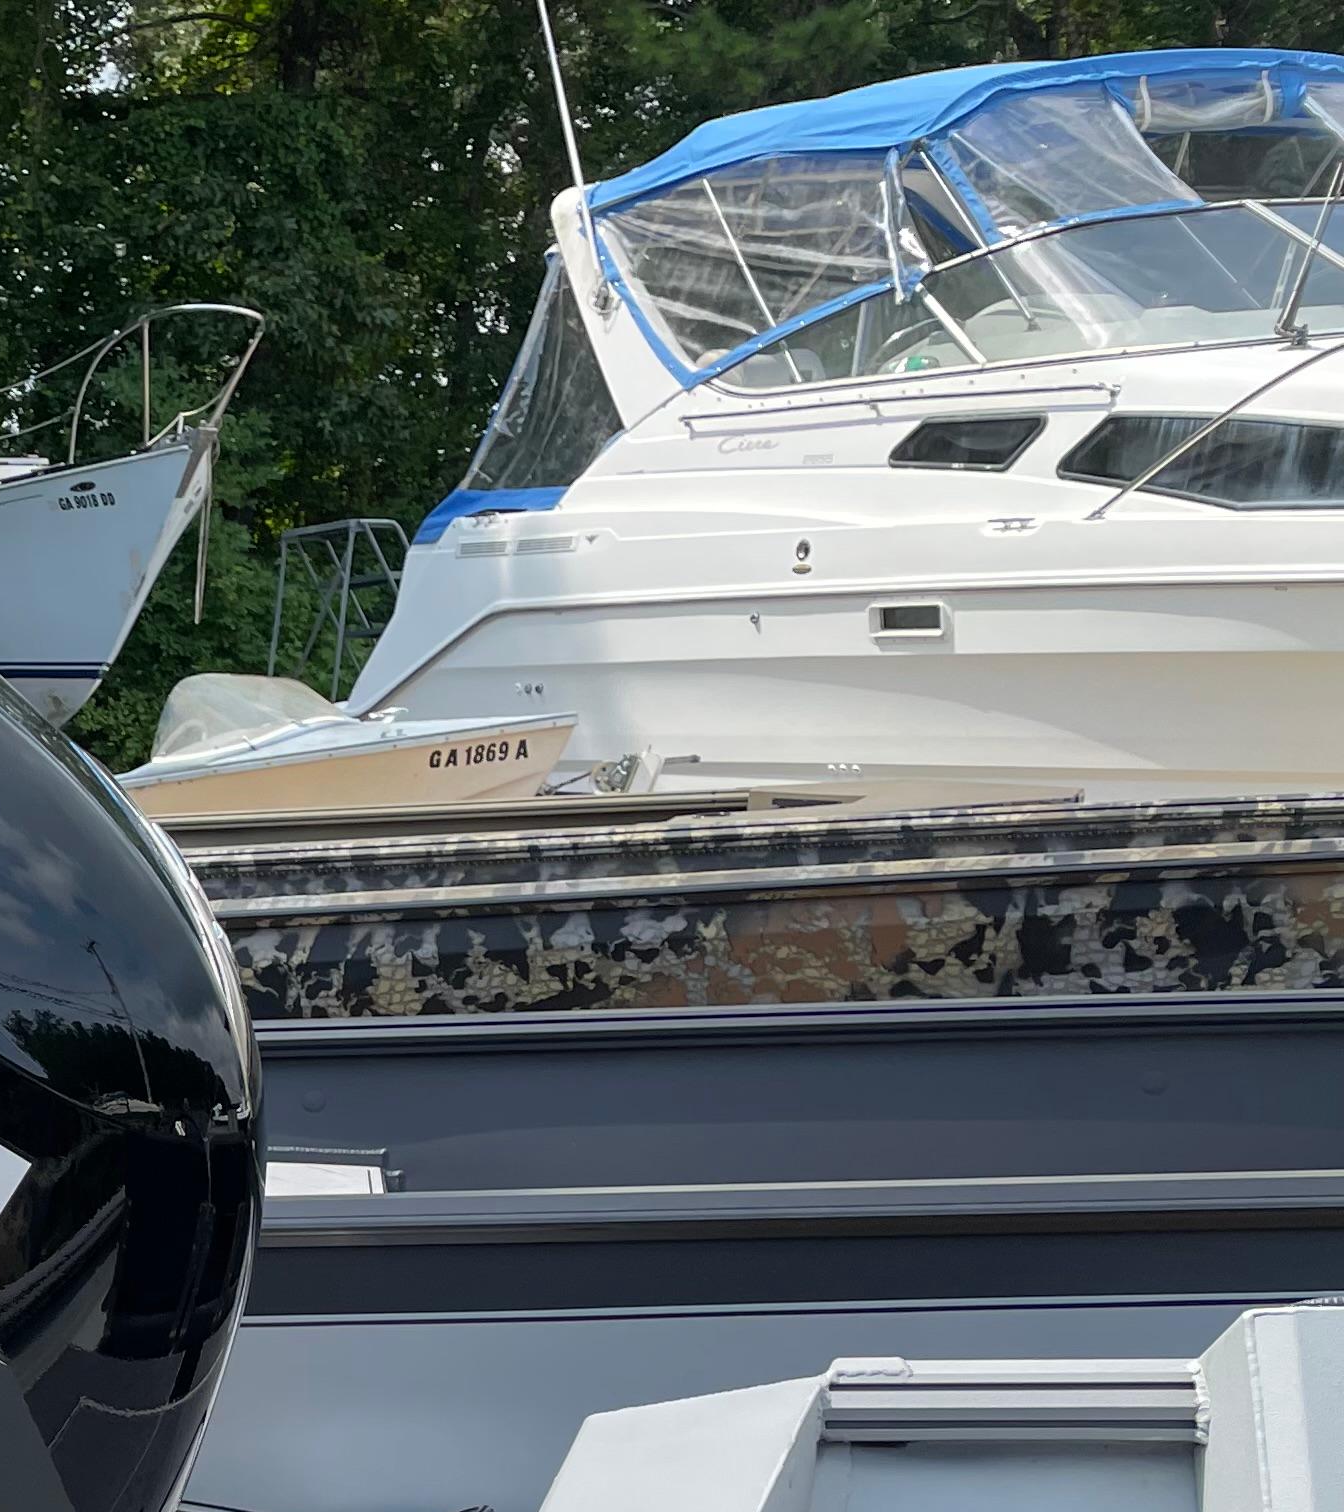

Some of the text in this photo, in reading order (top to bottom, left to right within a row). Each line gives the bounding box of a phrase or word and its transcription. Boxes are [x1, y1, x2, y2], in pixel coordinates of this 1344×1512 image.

[58, 497, 74, 510] GA
[429, 738, 529, 768] GA 1869 A
